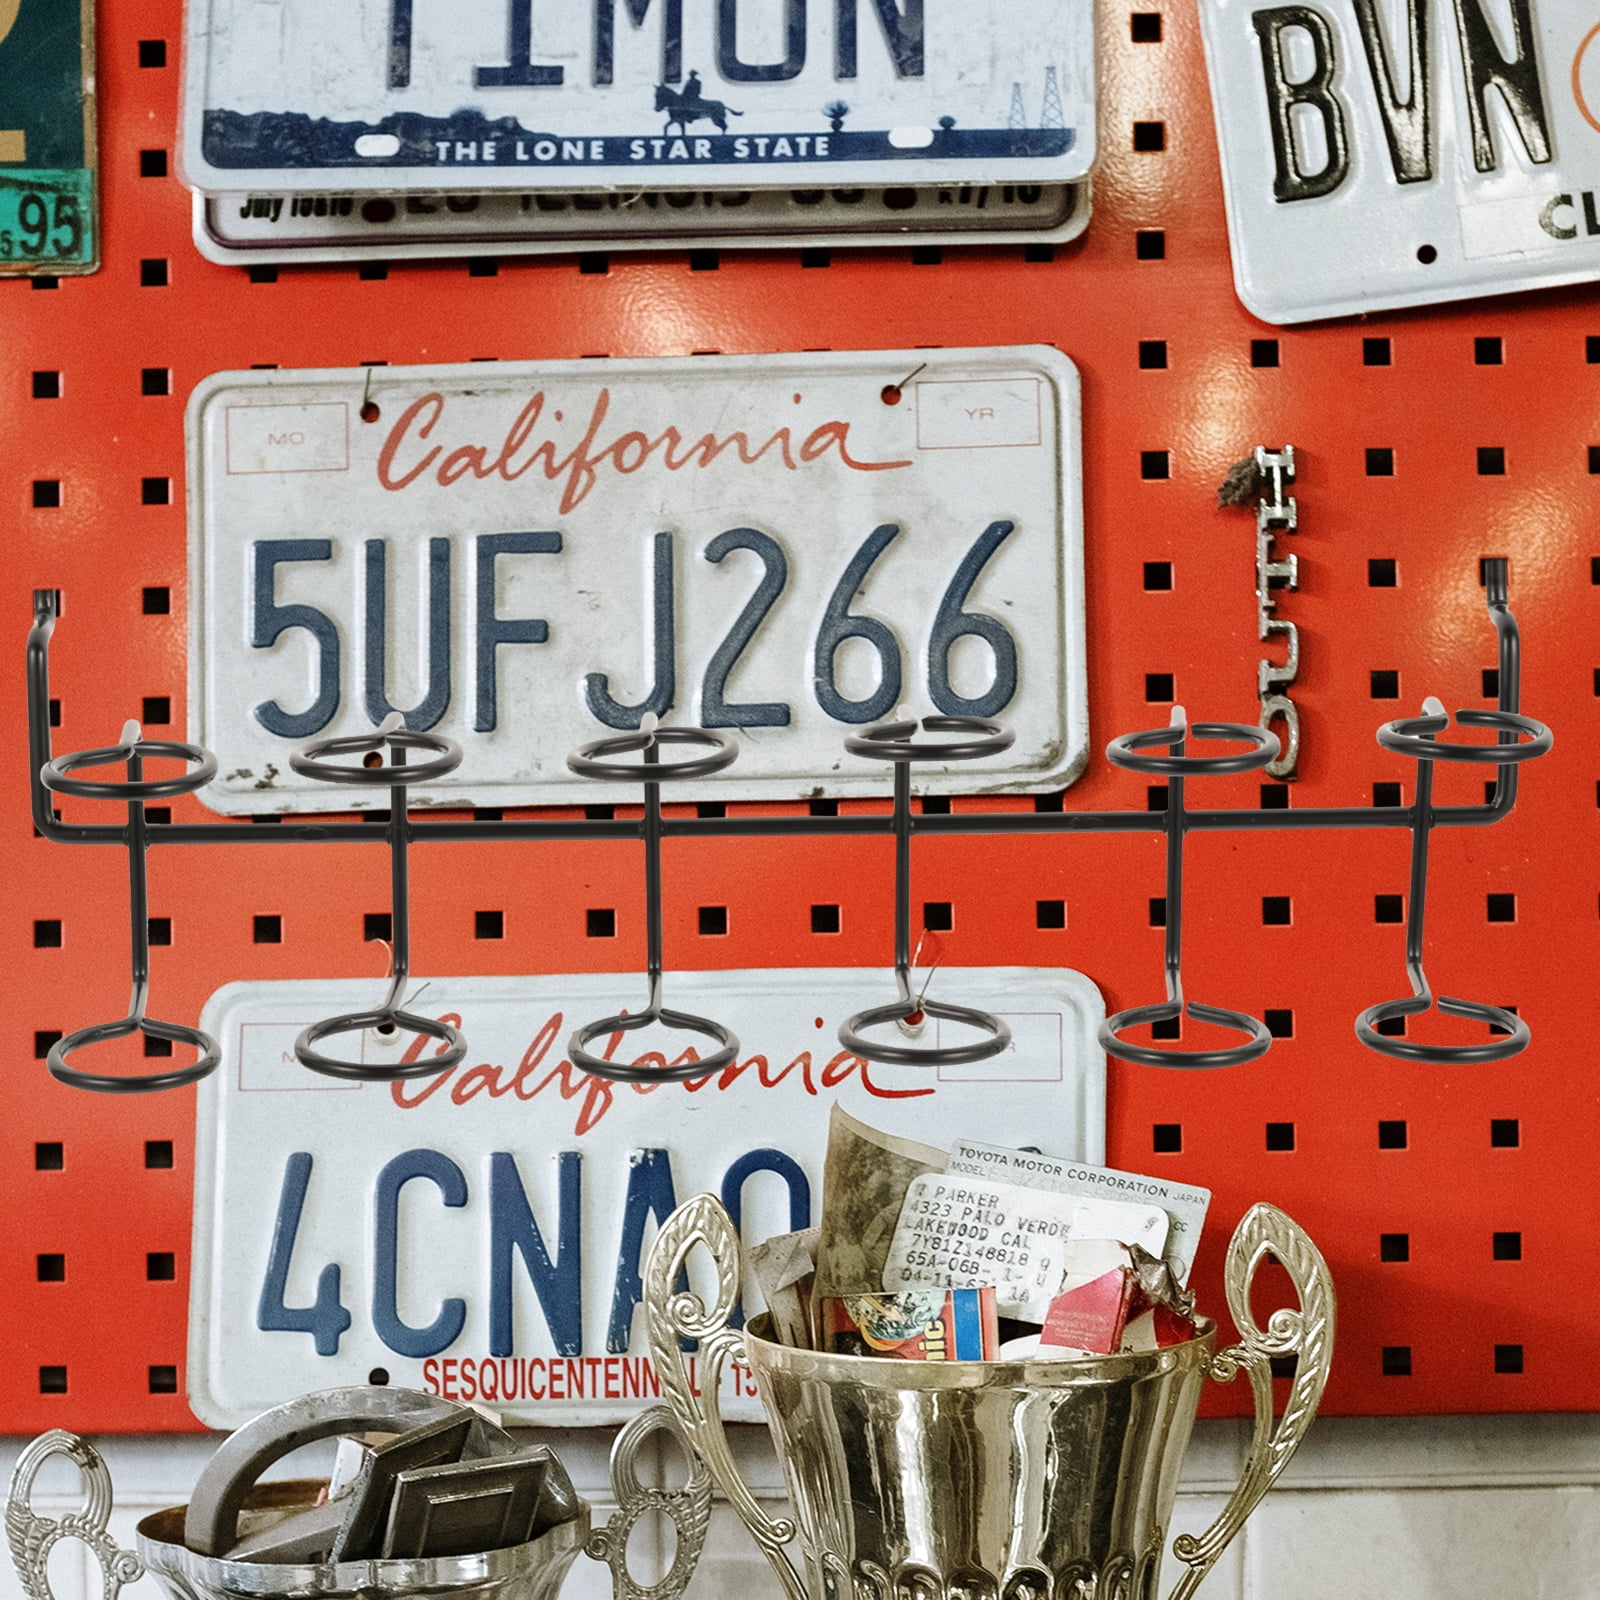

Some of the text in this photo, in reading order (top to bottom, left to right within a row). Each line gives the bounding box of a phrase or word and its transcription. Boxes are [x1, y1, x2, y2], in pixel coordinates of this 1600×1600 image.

[1252, 0, 1552, 204] BVN
[436, 136, 830, 162] THE LONE STAR STATE
[18, 192, 83, 256] 95
[965, 407, 996, 421] YR
[267, 431, 306, 446] MO
[377, 388, 913, 515] California
[391, 1009, 936, 1136] California
[950, 1160, 987, 1178] MODEL
[958, 1147, 1008, 1166] TOYOTA
[1013, 1158, 1063, 1177] MOTOR
[1067, 1169, 1170, 1199] CORPORATION
[1172, 1191, 1207, 1207] JAPAN
[934, 1186, 1000, 1209] PARKER
[1001, 1231, 1032, 1250] CAL
[1017, 1216, 1071, 1240] VERDE
[423, 1357, 702, 1401] SESQUICENTENNL
